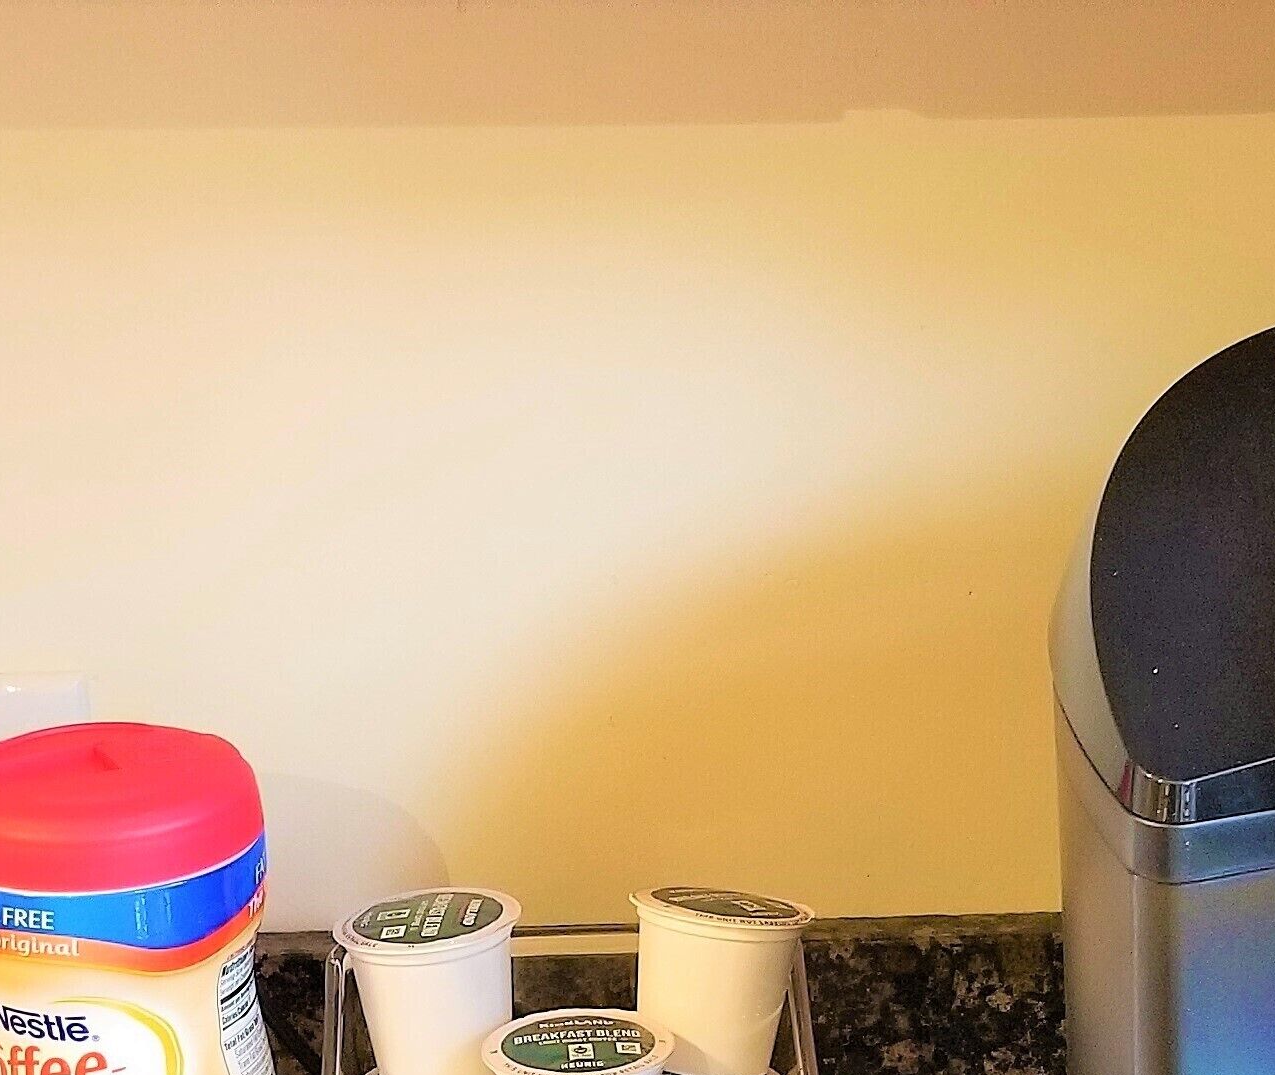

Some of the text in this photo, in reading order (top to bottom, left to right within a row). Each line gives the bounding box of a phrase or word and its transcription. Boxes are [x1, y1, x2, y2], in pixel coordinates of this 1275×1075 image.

[2, 907, 55, 931] FREE
[513, 1028, 641, 1046] BREAKFAST BLEND
